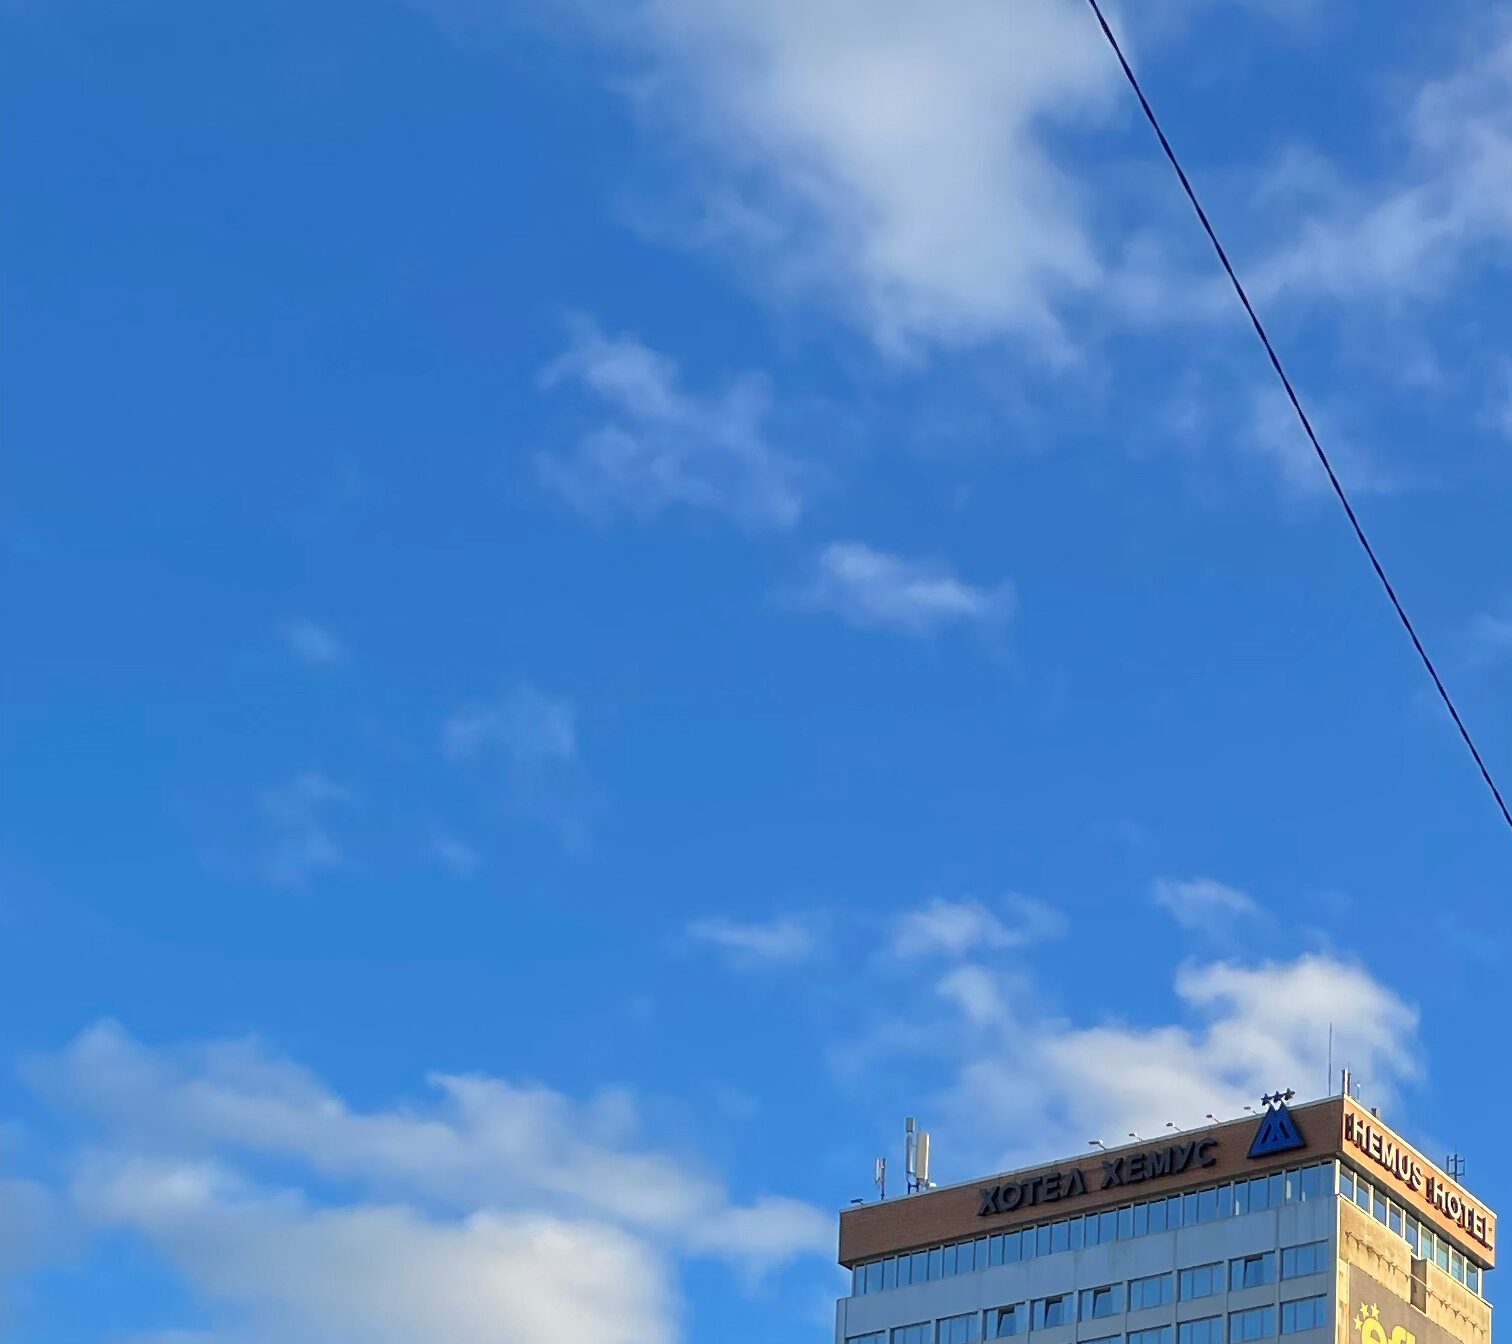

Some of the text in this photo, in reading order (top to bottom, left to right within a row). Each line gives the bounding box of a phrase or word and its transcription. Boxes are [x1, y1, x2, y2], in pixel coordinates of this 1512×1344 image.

[977, 1137, 1217, 1216] ХОТЕЛ ХЕМУС
[1346, 1112, 1493, 1250] HEMUS HOTEL
